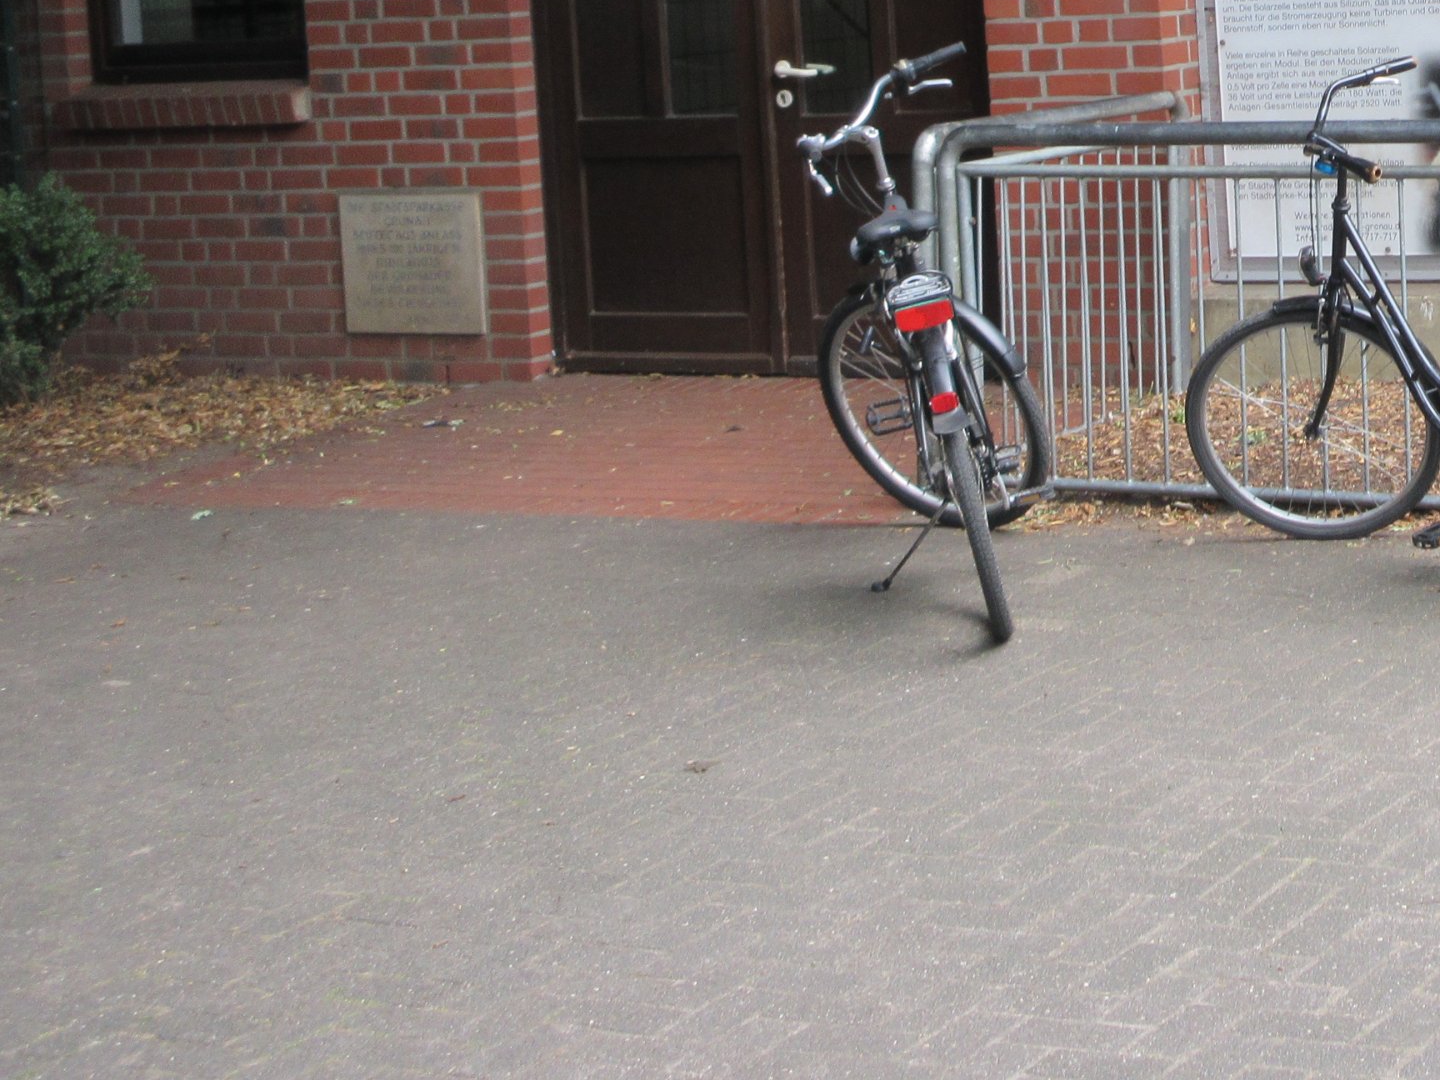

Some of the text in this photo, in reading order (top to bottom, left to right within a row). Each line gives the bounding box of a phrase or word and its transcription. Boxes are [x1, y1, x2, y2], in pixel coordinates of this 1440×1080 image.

[1253, 2, 1290, 11] Solarzelle
[1292, 0, 1321, 9] besteht
[1222, 14, 1252, 23] braucht
[1254, 13, 1265, 21] für
[1267, 13, 1279, 21] die
[1281, 10, 1347, 22] Stromerzeugung
[1348, 9, 1370, 17] keine
[1373, 7, 1407, 16] Turbinen
[1409, 6, 1425, 14] und
[1267, 22, 1299, 31] sondern
[1301, 21, 1321, 29] eben
[1225, 44, 1399, 59] Viele einzelne in Reihe geschaltete Solarzellen
[1225, 61, 1257, 71] ergeben
[1259, 60, 1271, 68] ein
[1304, 58, 1316, 66] Bei
[1319, 58, 1335, 66] den
[1337, 56, 1373, 65] Modulen
[1226, 71, 1253, 81] Anlage
[1256, 70, 1279, 80] ergibt
[1282, 69, 1298, 77] sich
[1318, 68, 1338, 76] einer
[1240, 82, 1254, 90] Volt
[1256, 83, 1269, 91] pro
[1270, 81, 1289, 89] Zelle
[1290, 80, 1307, 88] eine
[1227, 93, 1237, 101] 36
[1257, 92, 1272, 100] und
[1274, 91, 1291, 99] eine
[1389, 87, 1402, 95] die
[1360, 98, 1380, 106] 2520
